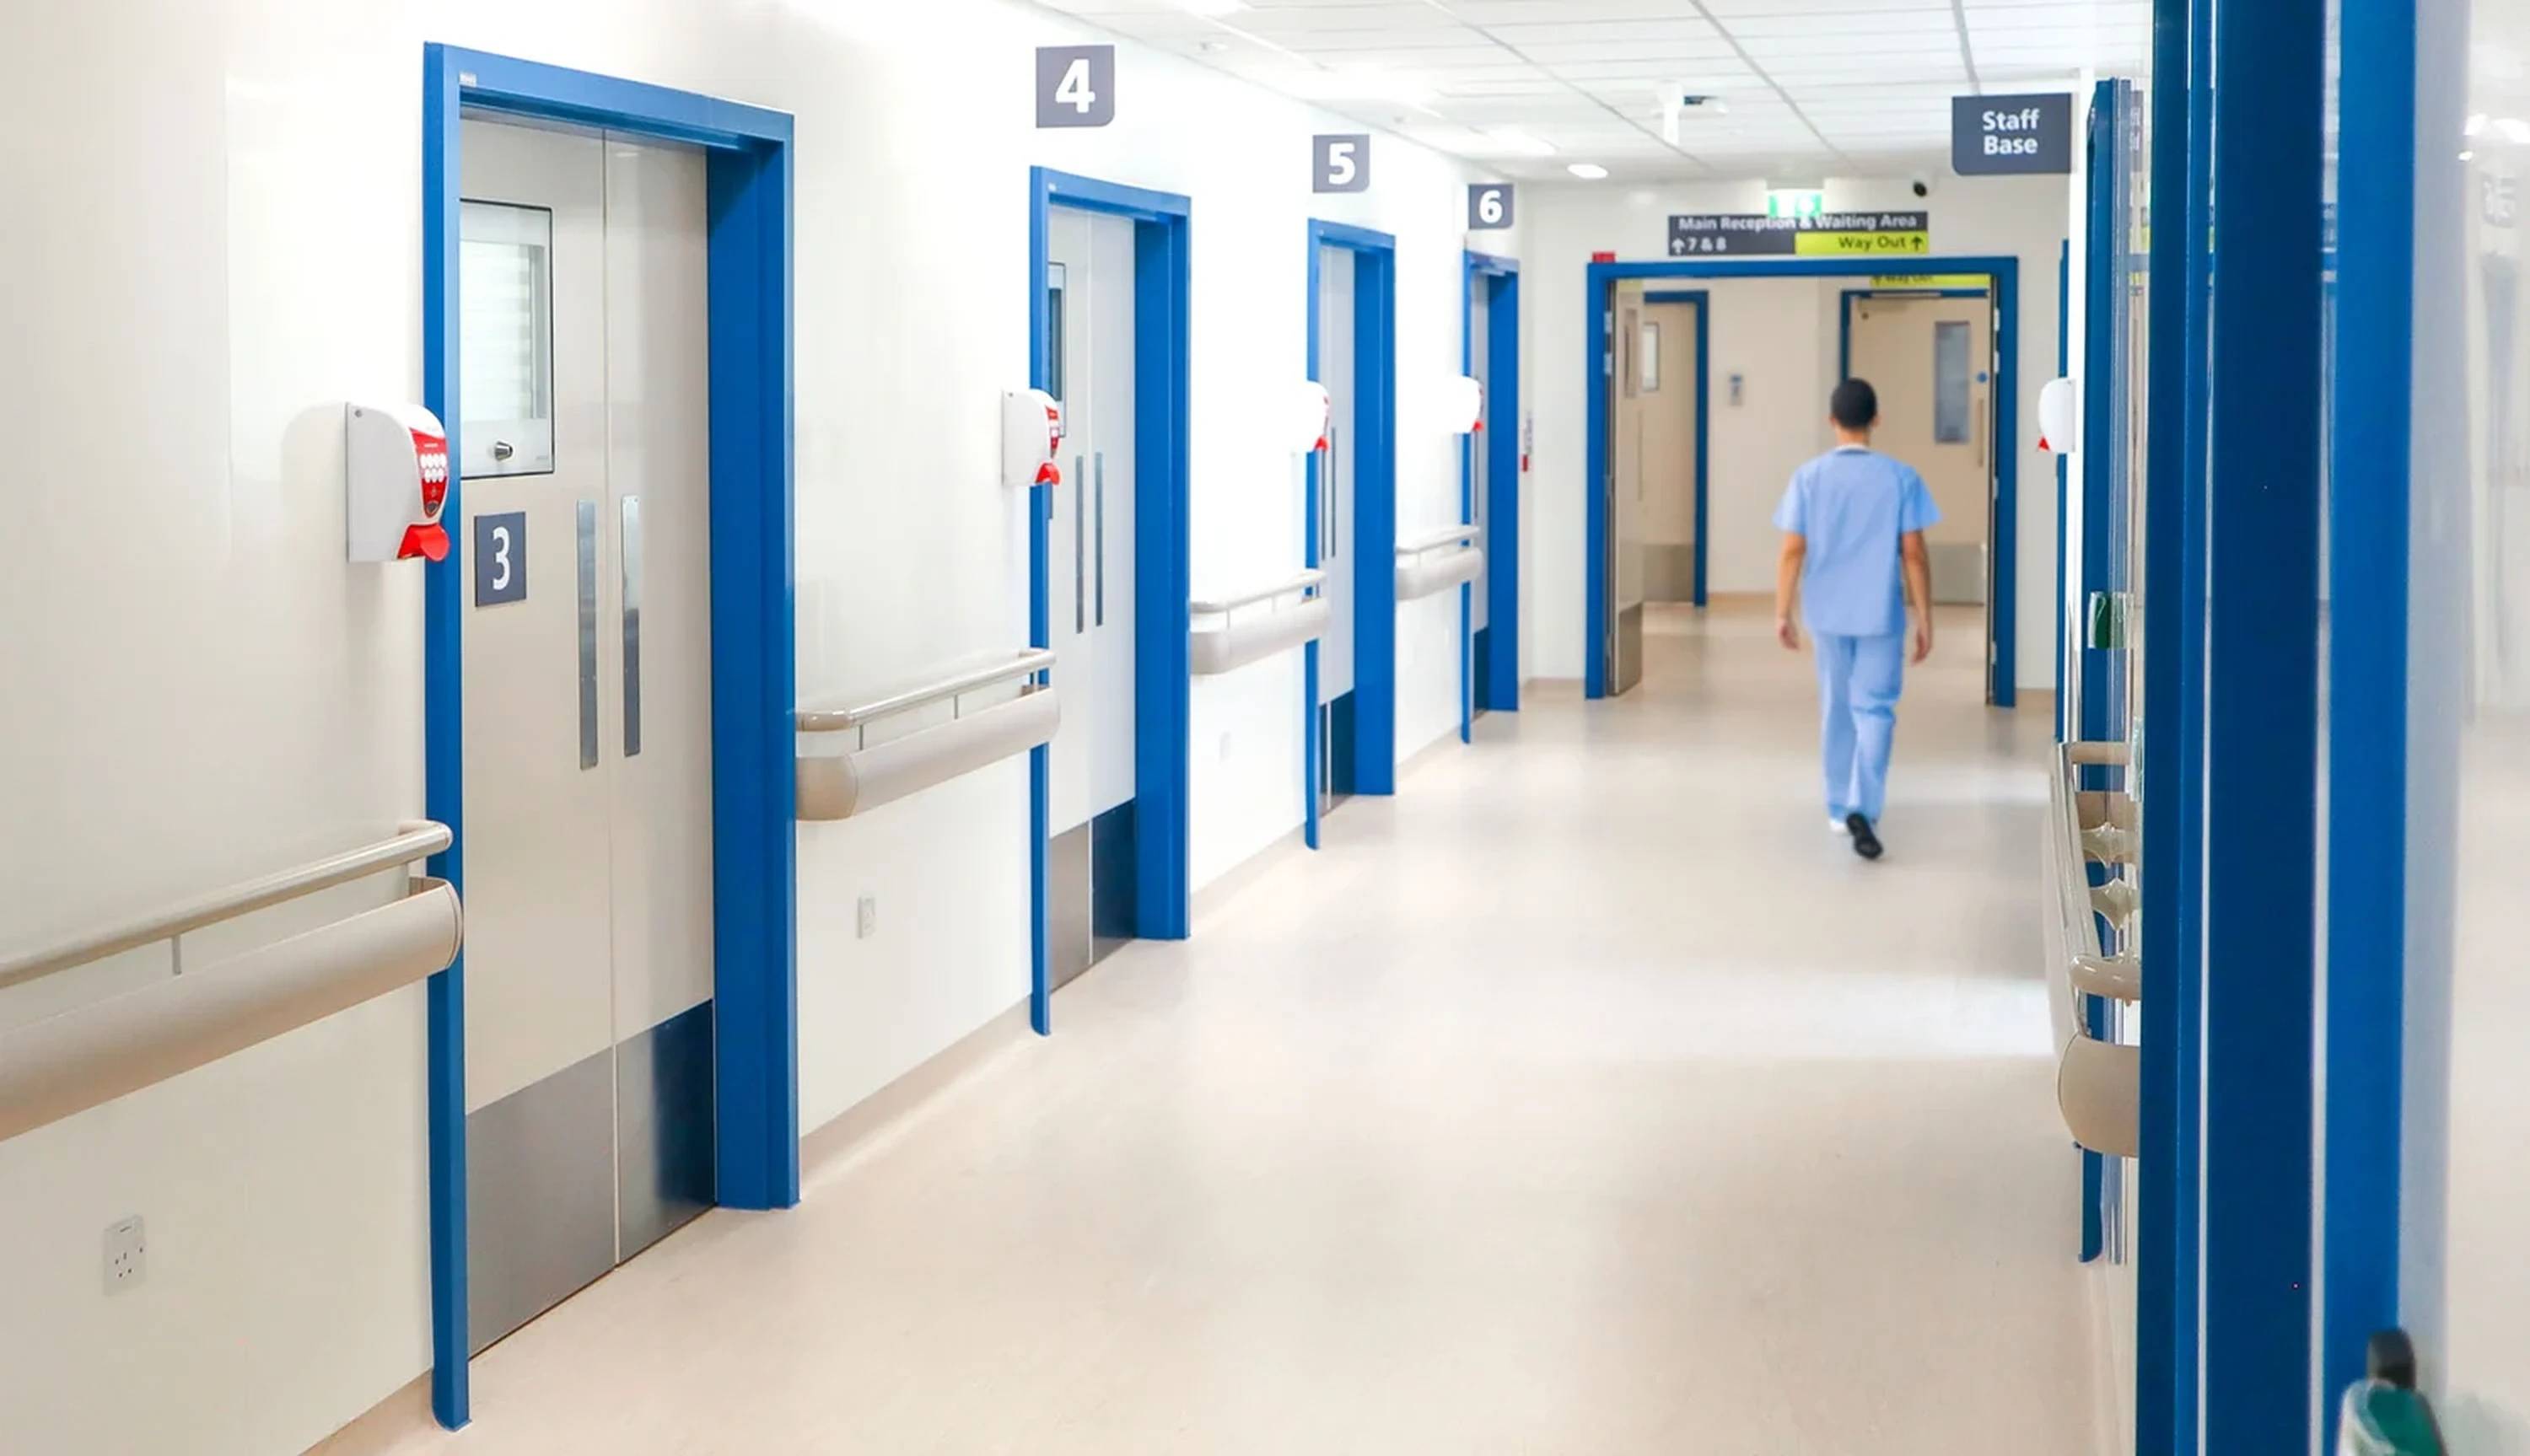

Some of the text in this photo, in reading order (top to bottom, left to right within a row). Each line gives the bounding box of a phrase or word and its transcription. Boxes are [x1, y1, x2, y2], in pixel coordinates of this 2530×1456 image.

[1055, 59, 1095, 113] 4
[1983, 109, 2040, 131] Staff
[1984, 135, 2038, 155] Base
[1328, 142, 1356, 185] 5
[1479, 191, 1502, 223] 6
[1678, 218, 1717, 230] Main
[1720, 217, 1795, 233] Reception
[1814, 215, 1877, 231] Waiting
[1880, 214, 1917, 228] Area
[1688, 238, 1727, 251] 7 & 8
[1838, 236, 1907, 254] Way Out
[493, 526, 511, 591] 3
